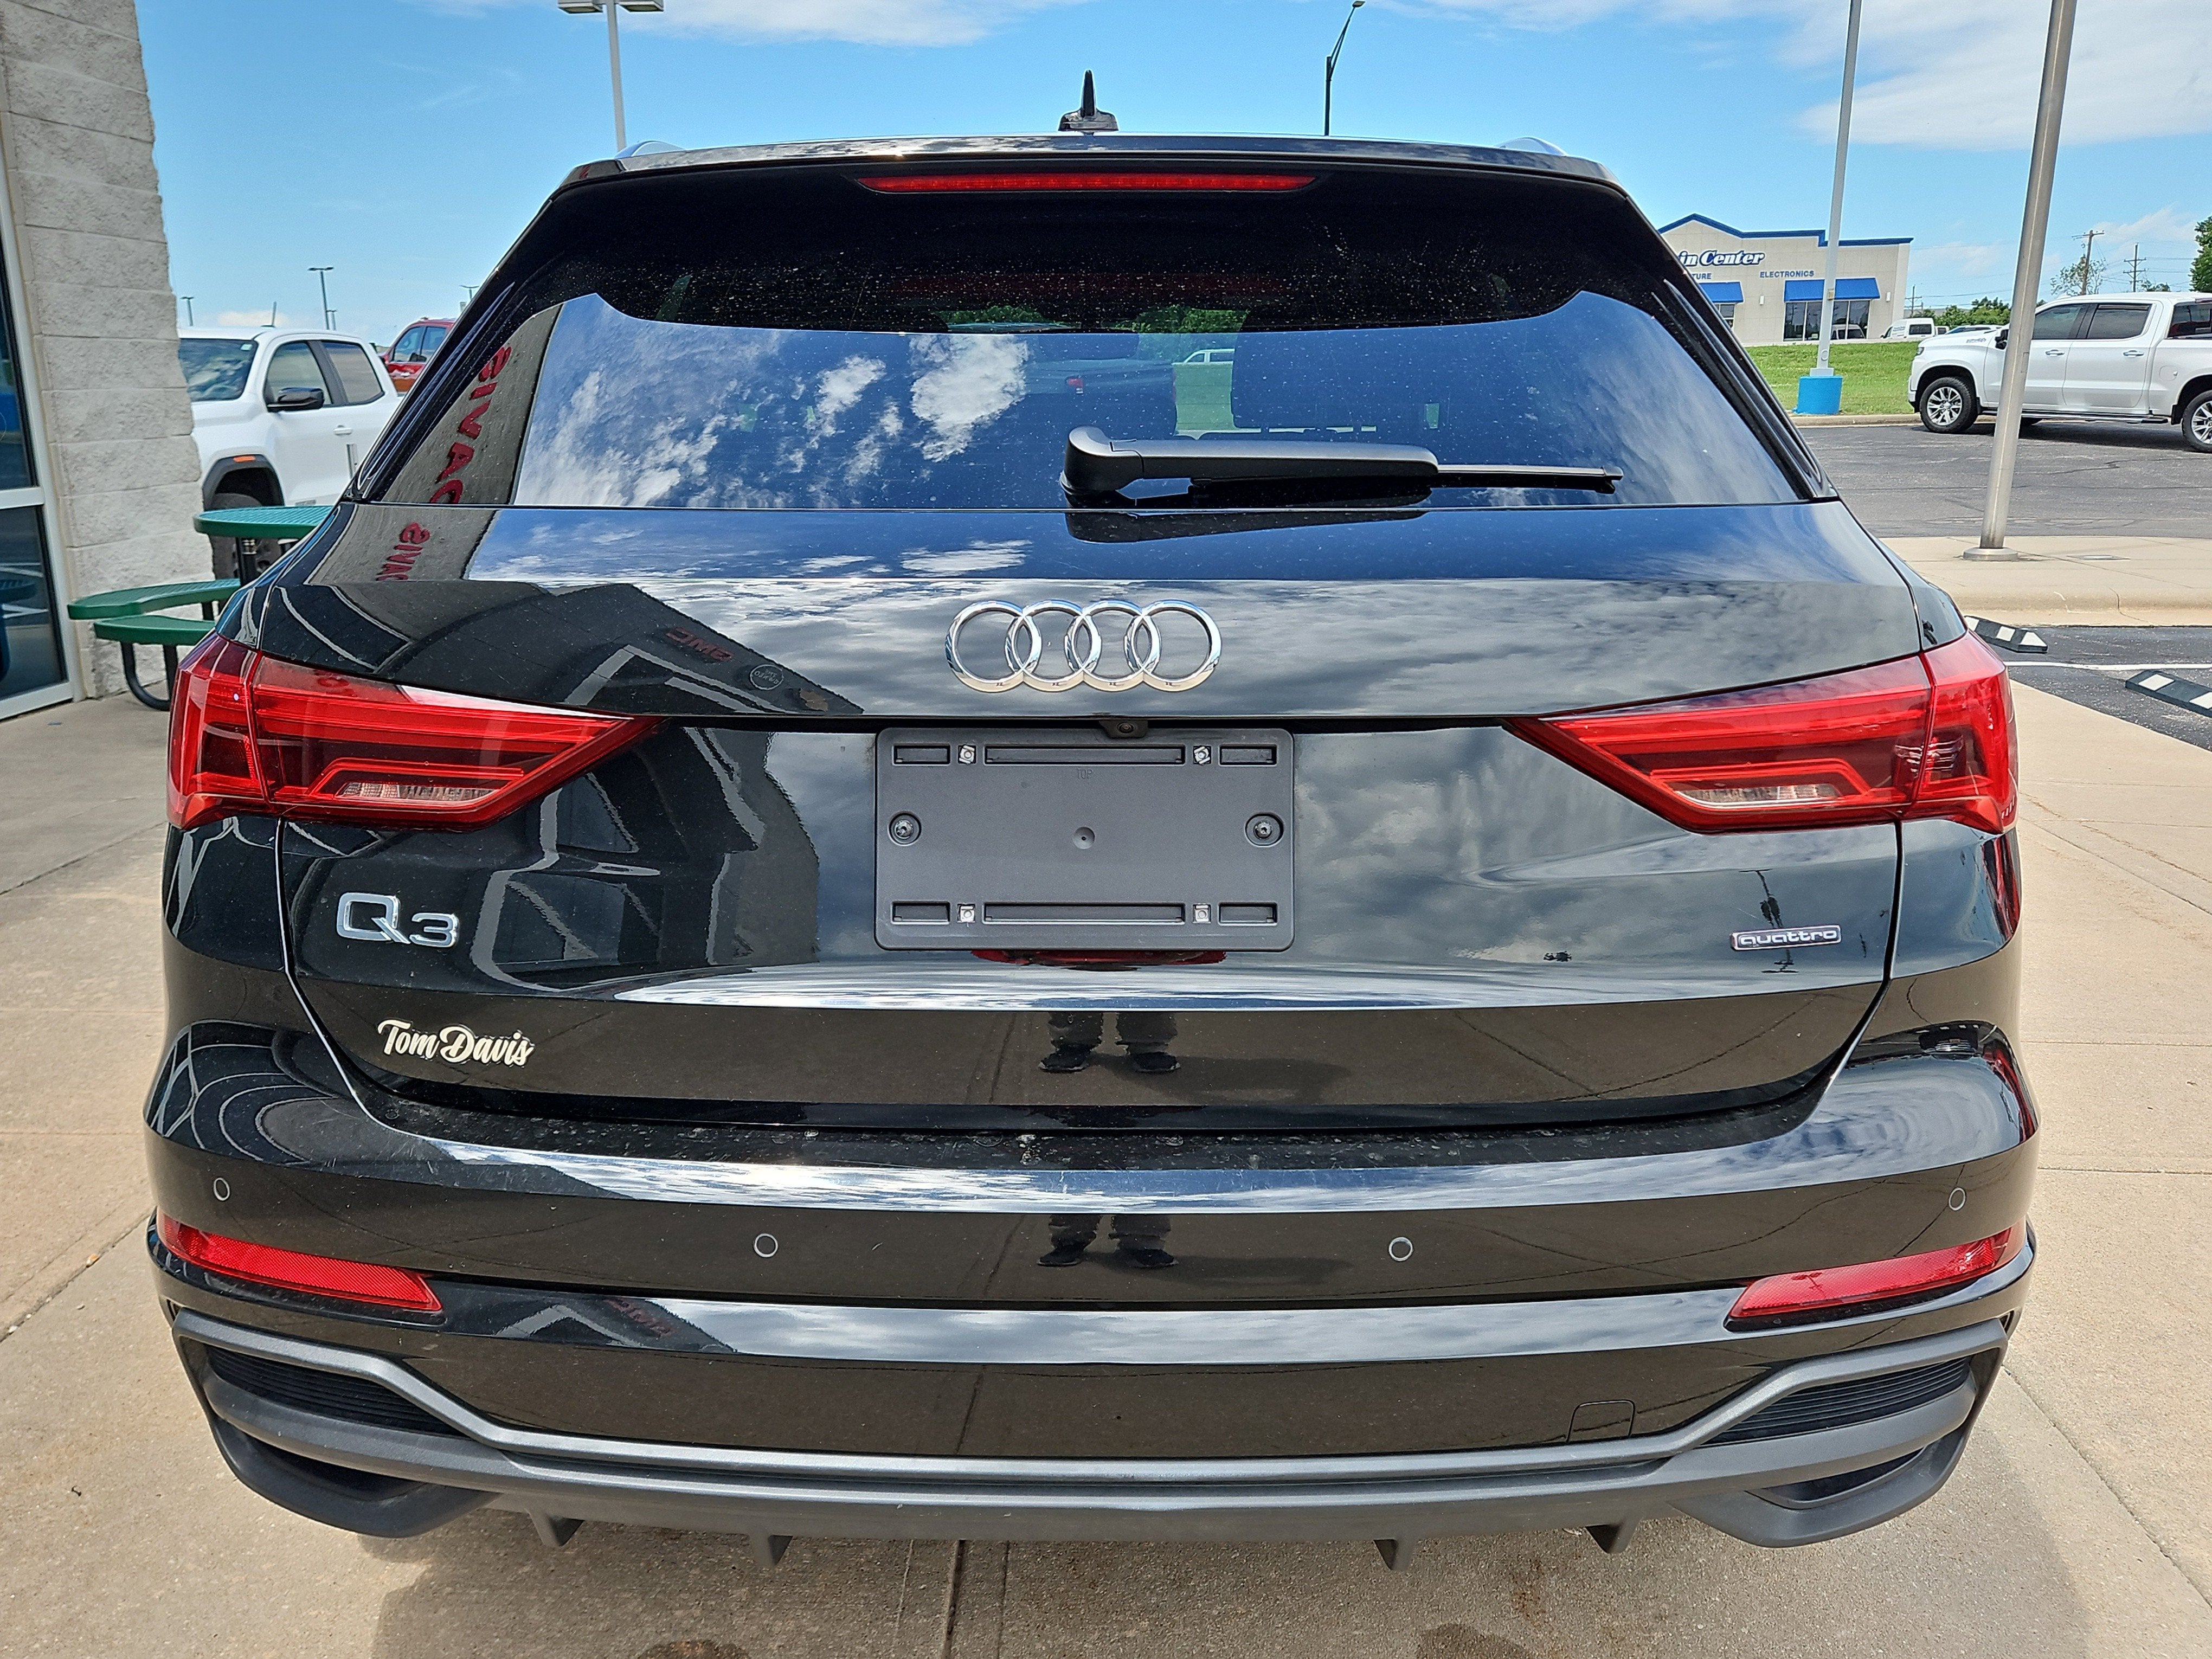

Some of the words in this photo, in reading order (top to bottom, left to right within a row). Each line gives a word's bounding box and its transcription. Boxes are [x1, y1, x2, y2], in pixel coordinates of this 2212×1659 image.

[1679, 250, 1698, 266] in
[1699, 250, 1765, 266] Center
[1759, 270, 1815, 278] ELECTRONICS
[1077, 768, 1094, 779] TOP
[336, 892, 460, 948] Q3
[1740, 929, 1837, 947] quattro
[377, 1019, 440, 1060] Tom
[439, 1025, 535, 1066] Davis
